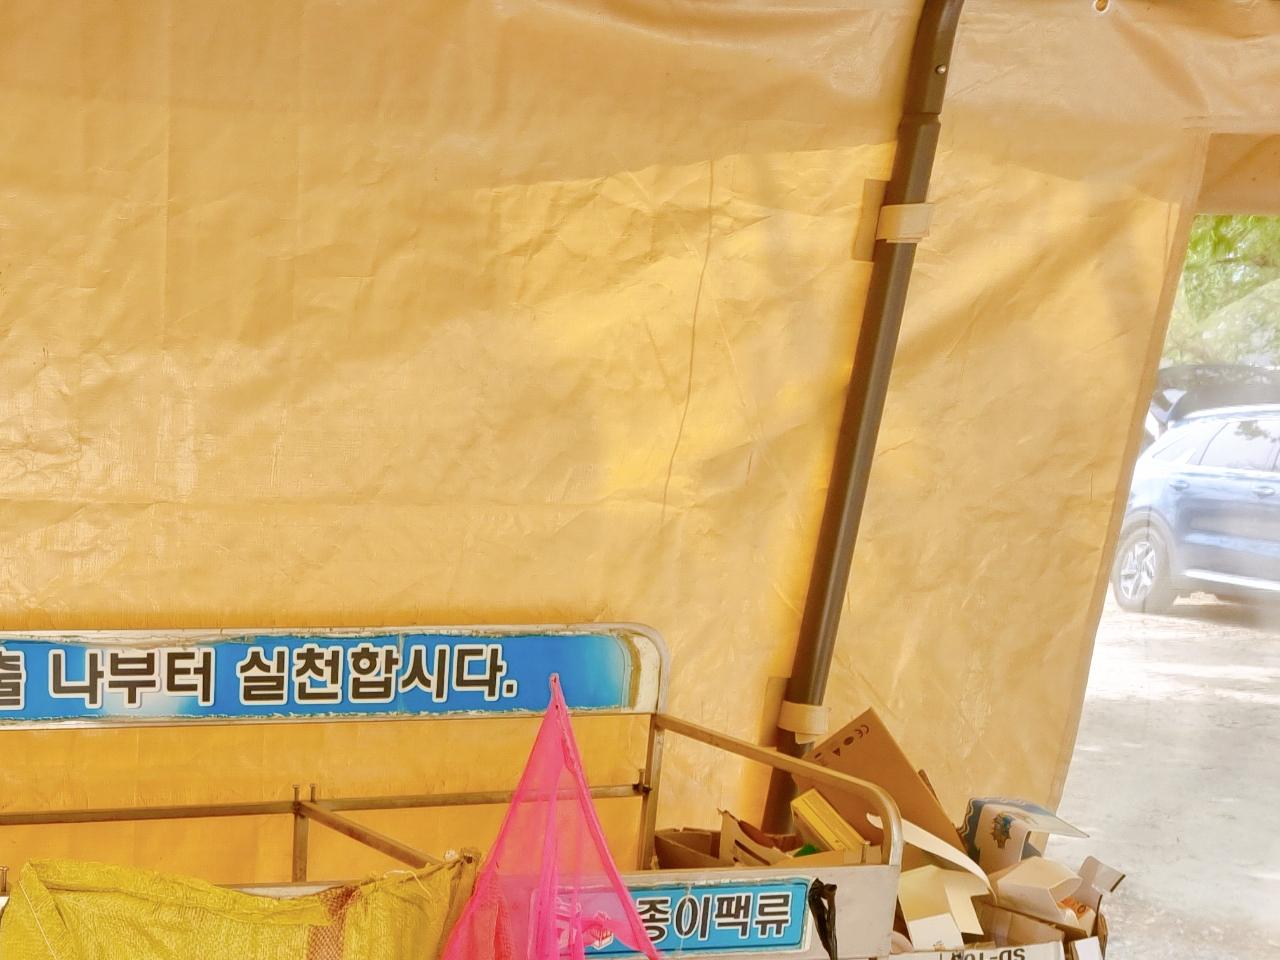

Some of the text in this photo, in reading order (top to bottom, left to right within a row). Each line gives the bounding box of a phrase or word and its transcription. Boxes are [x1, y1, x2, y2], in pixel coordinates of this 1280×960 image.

[49, 645, 216, 707] 나부터
[237, 645, 518, 705] 실천합시다.
[636, 890, 793, 943] 종이팩류
